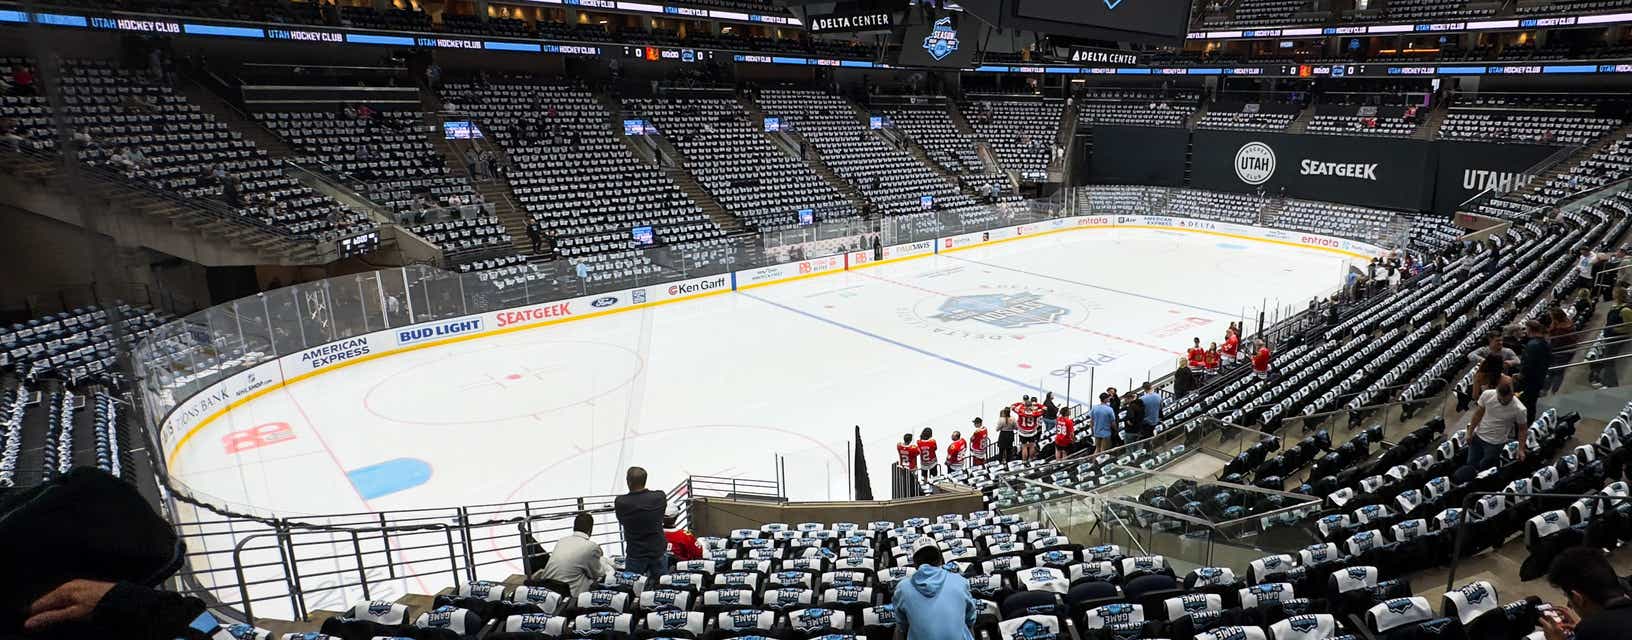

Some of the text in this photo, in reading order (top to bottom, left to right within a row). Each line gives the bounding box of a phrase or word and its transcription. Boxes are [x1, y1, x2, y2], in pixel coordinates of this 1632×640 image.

[91, 17, 181, 34] UTAH HOCKEY CLUB
[820, 14, 889, 29] DELTA CENTER
[268, 29, 343, 42] UTAH HOCKEY CLUB
[418, 38, 482, 49] UTAH HOCKEY CLUB
[1081, 52, 1137, 65] DELTA CENTER
[1599, 64, 1616, 73] UTAH
[1241, 156, 1270, 172] UTAH
[1300, 158, 1378, 181] SEATGEEK
[1463, 169, 1514, 193] UTAH
[1188, 221, 1216, 231] DELTA
[1301, 235, 1340, 249] entrata
[678, 277, 725, 295] Ken Garff
[496, 302, 573, 328] SEATGEEK
[399, 319, 480, 343] BUD LIGHT
[302, 336, 369, 362] AMERICAN
[312, 345, 371, 369] EXPRESS
[1021, 416, 1035, 427] 19
[969, 576, 989, 585] GAME
[470, 584, 490, 593] GAME
[528, 589, 547, 598] GAME
[838, 589, 858, 598] GAME
[591, 592, 613, 601] GAME
[655, 591, 675, 599] GAME
[719, 590, 740, 599] GAME
[778, 590, 799, 599] GAME
[1183, 594, 1206, 602] GAME
[1257, 592, 1280, 601] GAME
[429, 612, 451, 623] GAME
[522, 615, 547, 625] GAME
[591, 615, 614, 625] GAME
[663, 611, 687, 621] GAME
[734, 613, 757, 622] GAME
[806, 615, 831, 626] GAME
[878, 611, 896, 620] AME
[1104, 613, 1129, 623] GAME
